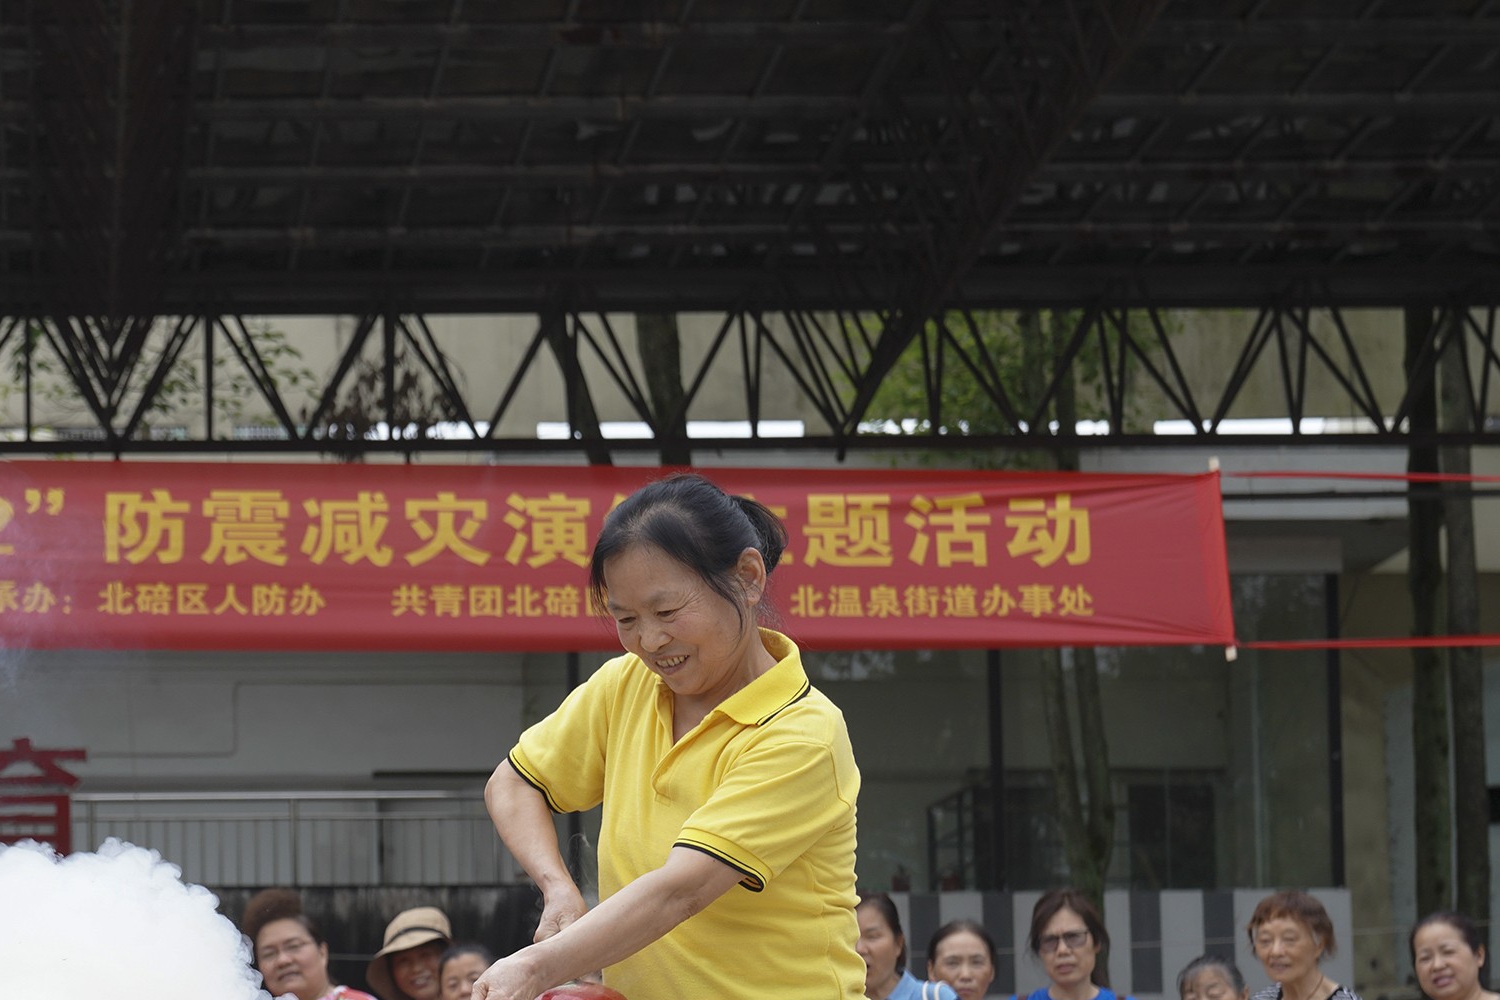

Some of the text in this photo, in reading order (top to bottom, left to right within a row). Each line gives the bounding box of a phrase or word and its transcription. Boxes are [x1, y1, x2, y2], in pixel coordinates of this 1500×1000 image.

[789, 583, 1095, 618] 北温泉街道办事处
